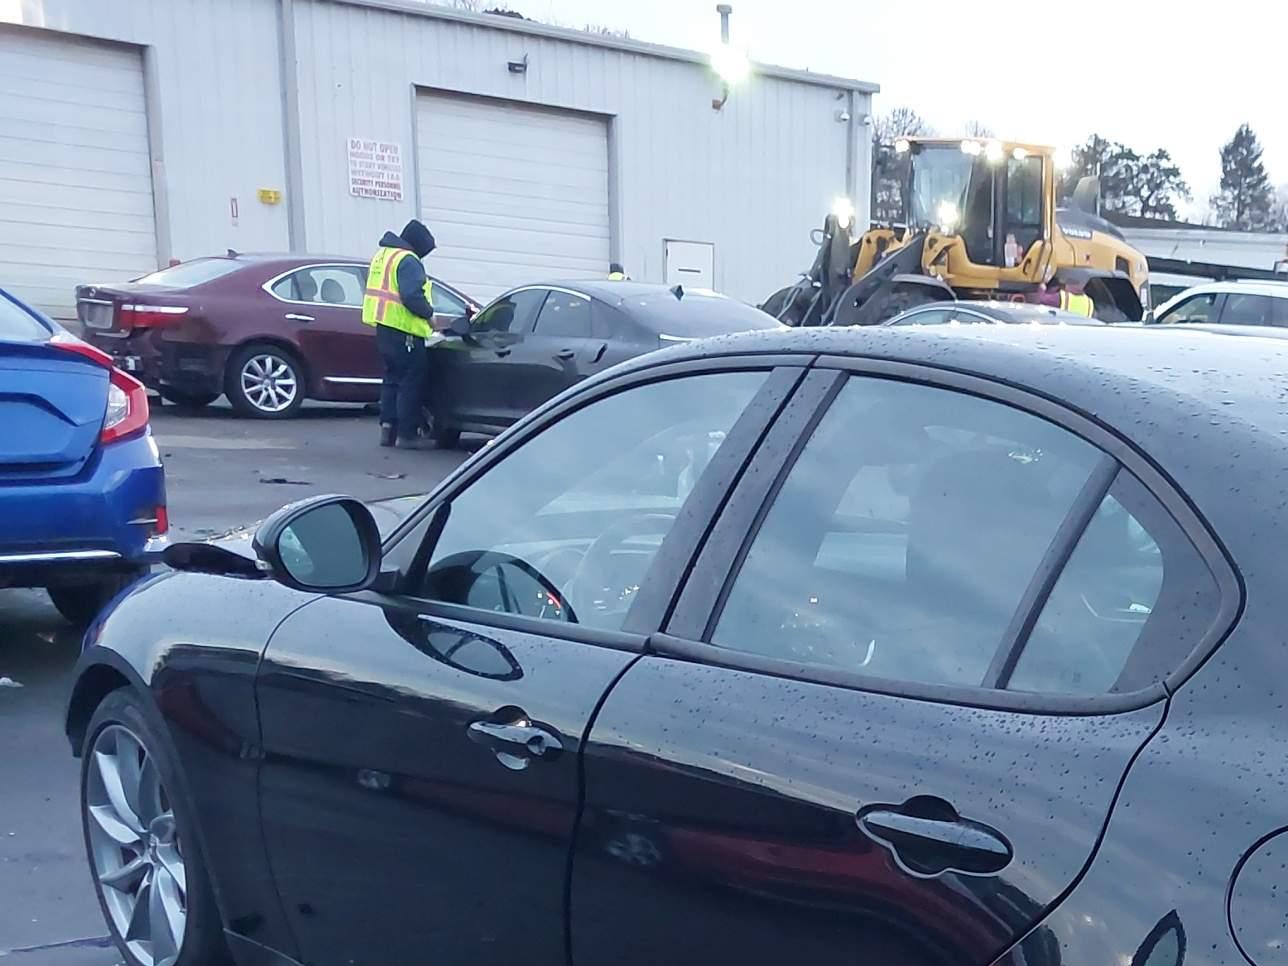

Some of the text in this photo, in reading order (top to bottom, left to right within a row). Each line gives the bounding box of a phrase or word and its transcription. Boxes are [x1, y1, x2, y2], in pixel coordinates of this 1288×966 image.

[351, 139, 399, 154] DO NOT OPEN
[351, 177, 401, 190] SECURITY PERSONNEL
[352, 186, 402, 199] AUTHORIZATION
